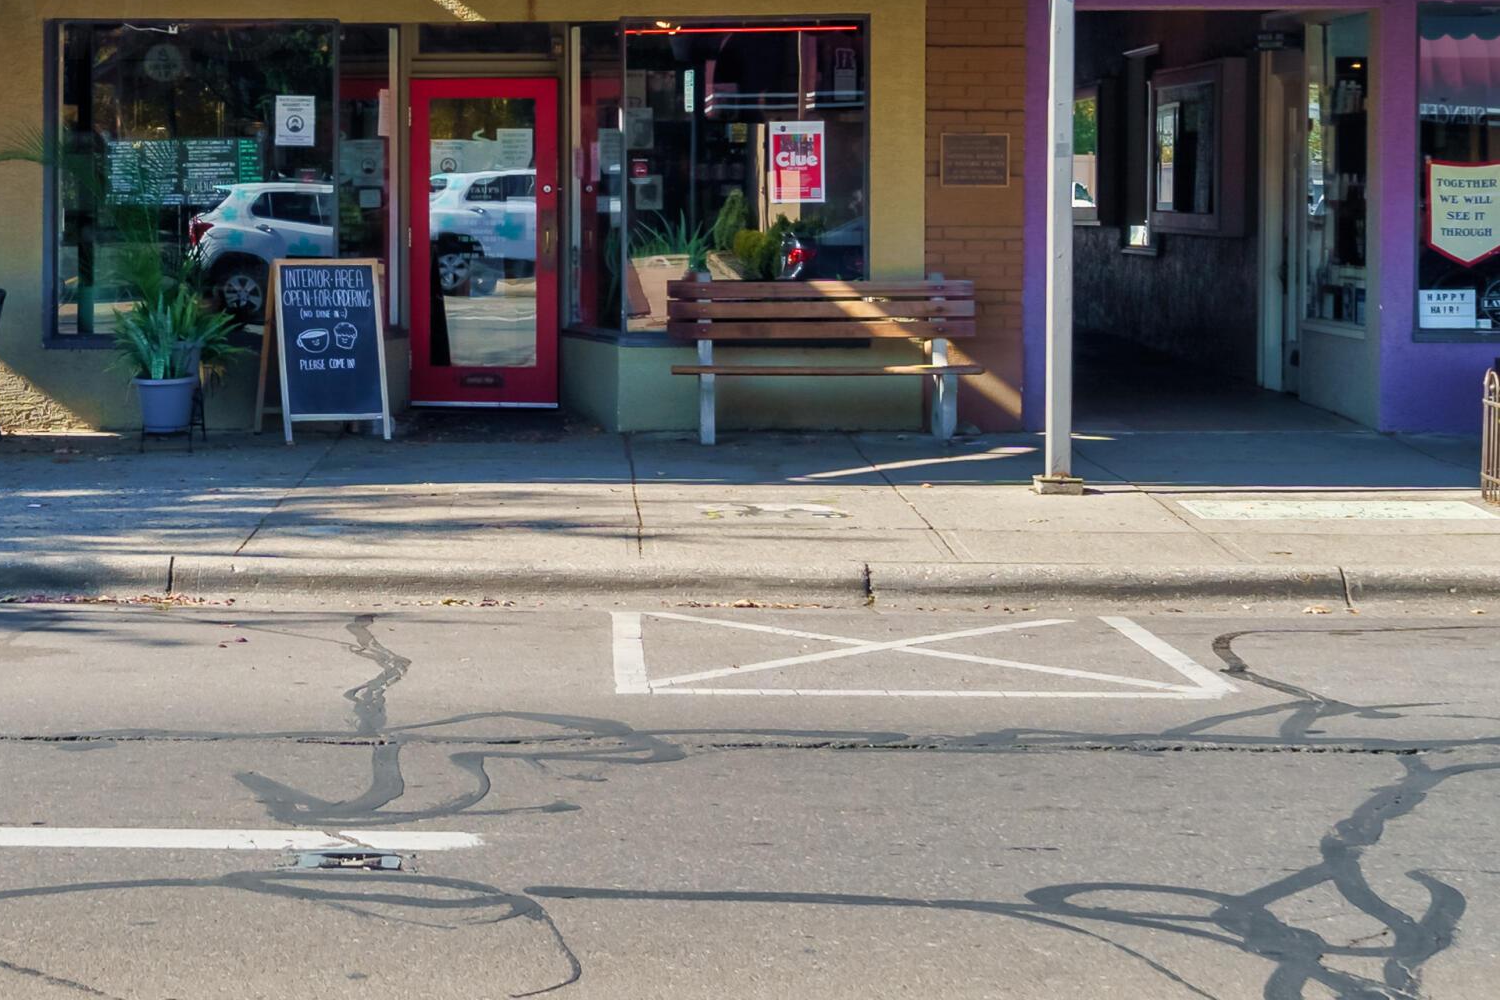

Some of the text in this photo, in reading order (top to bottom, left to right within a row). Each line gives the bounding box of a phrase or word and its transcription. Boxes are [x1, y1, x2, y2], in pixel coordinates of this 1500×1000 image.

[775, 151, 818, 167] Clue
[1436, 177, 1498, 188] TOGETHER
[1439, 194, 1493, 204] WE WILL
[1446, 211, 1485, 220] SEE IT
[1441, 227, 1493, 237] THROUGH
[1427, 293, 1465, 301] HAPPY
[1430, 306, 1460, 314] HAIR!
